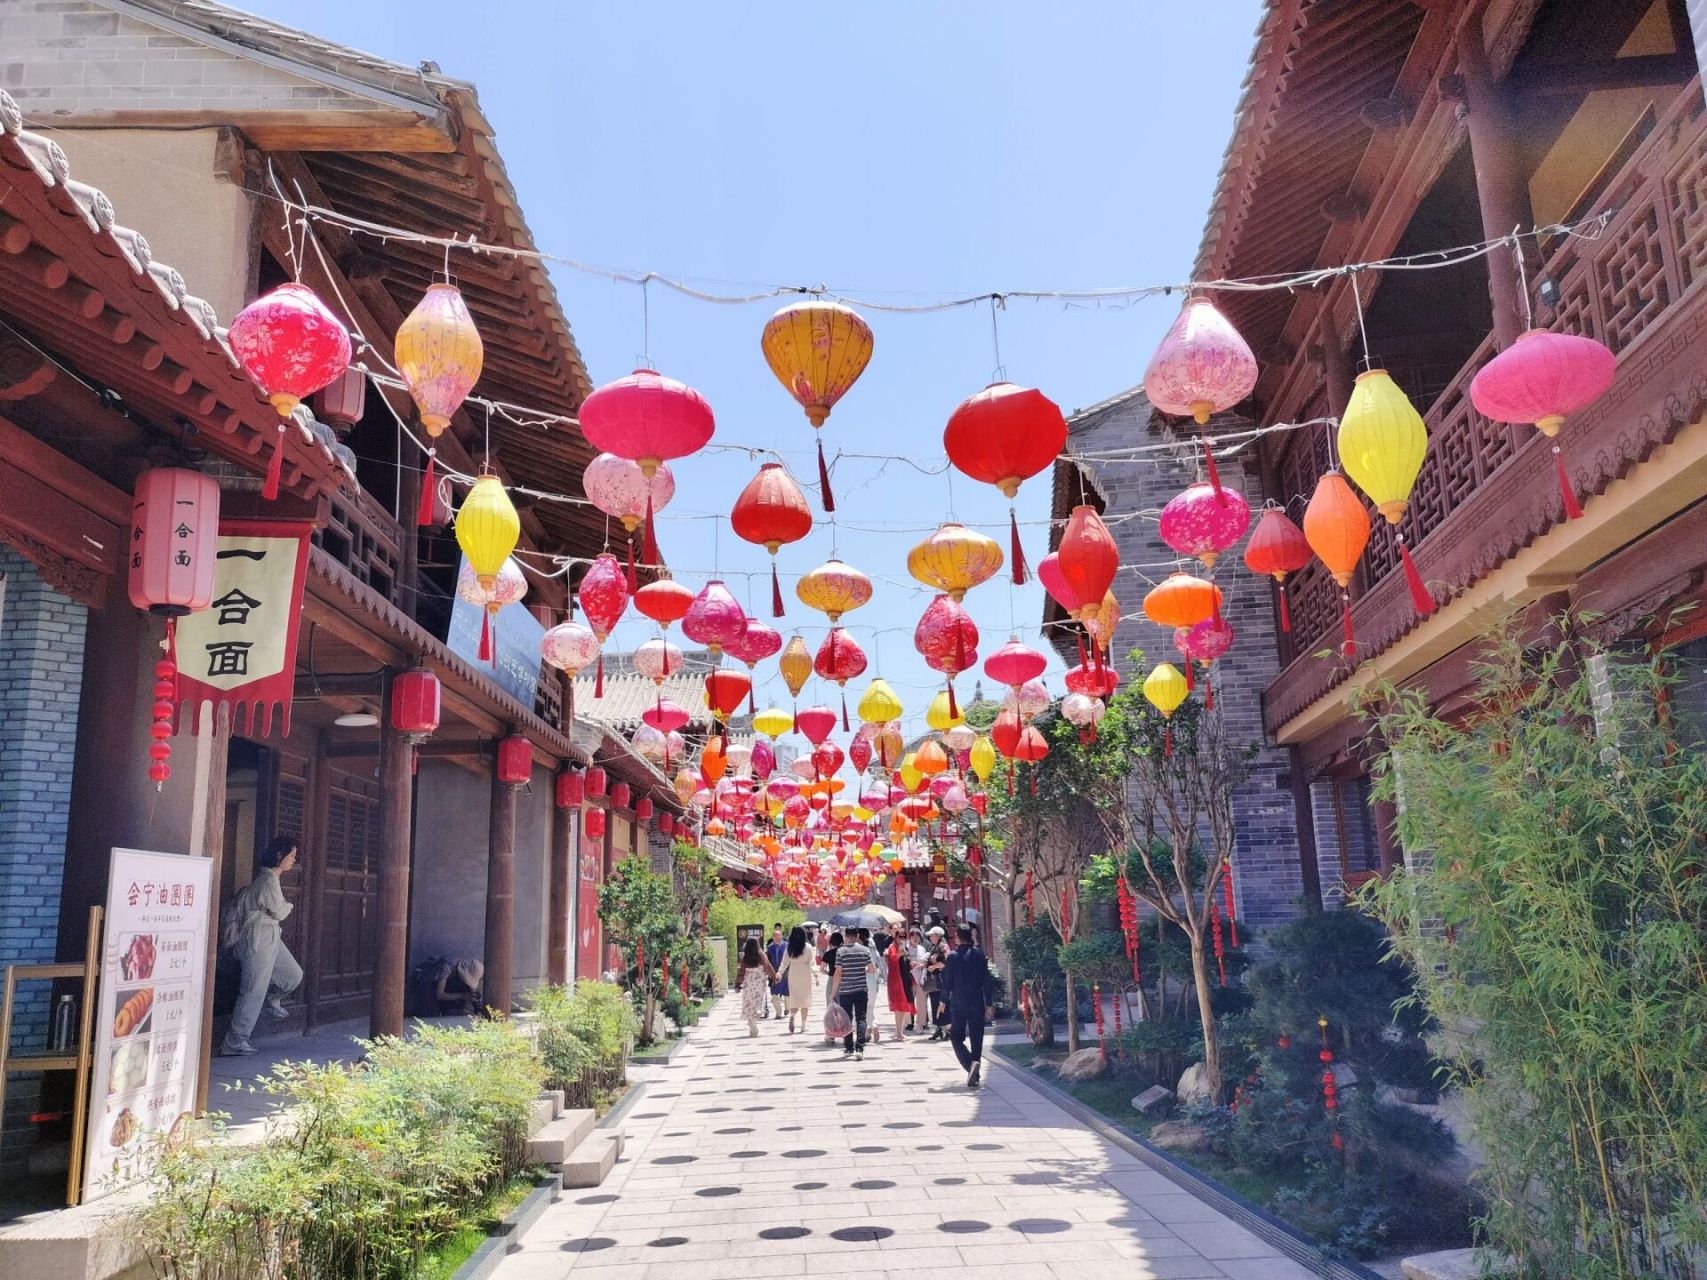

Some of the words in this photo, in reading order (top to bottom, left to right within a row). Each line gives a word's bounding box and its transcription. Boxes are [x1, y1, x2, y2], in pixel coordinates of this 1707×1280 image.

[131, 502, 145, 568] 一合面
[174, 500, 194, 567] 一合面
[205, 548, 267, 677] 一合面
